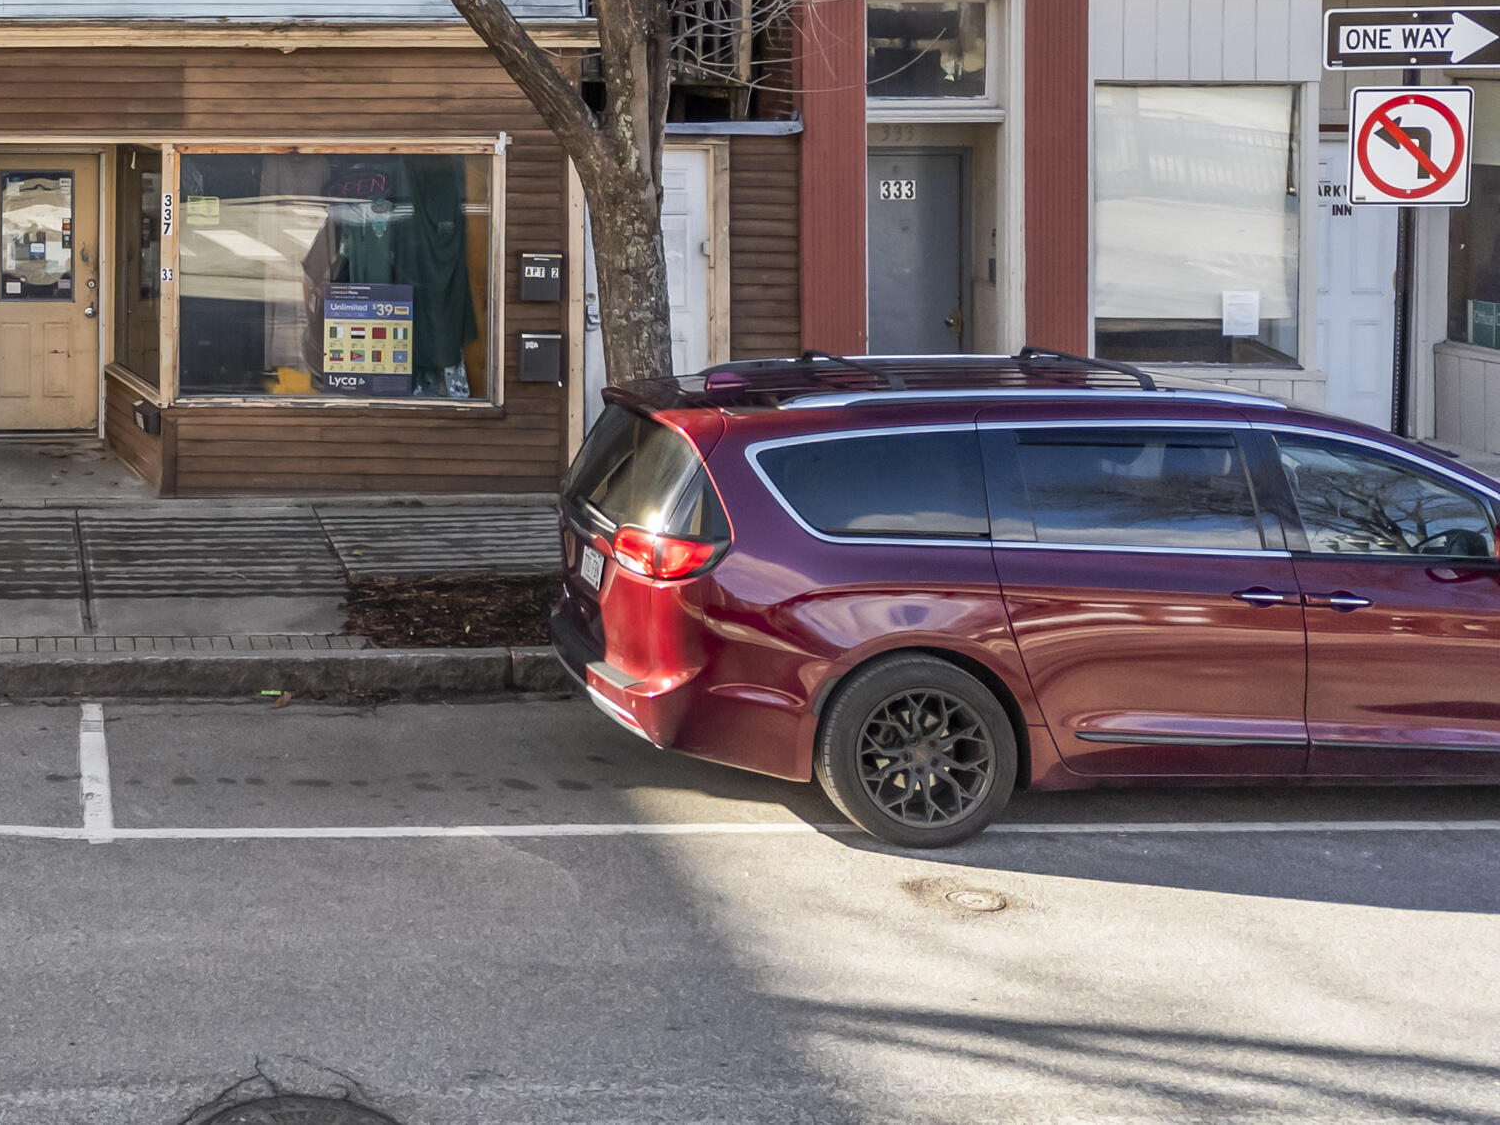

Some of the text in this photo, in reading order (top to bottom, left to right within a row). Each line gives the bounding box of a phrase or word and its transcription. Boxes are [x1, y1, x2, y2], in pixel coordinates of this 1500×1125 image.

[1345, 27, 1451, 50] ONE WAY
[882, 181, 914, 199] 333
[163, 194, 172, 235] 337
[1332, 204, 1352, 216] INN
[331, 303, 368, 312] Unlimited
[329, 375, 357, 387] Lyca
